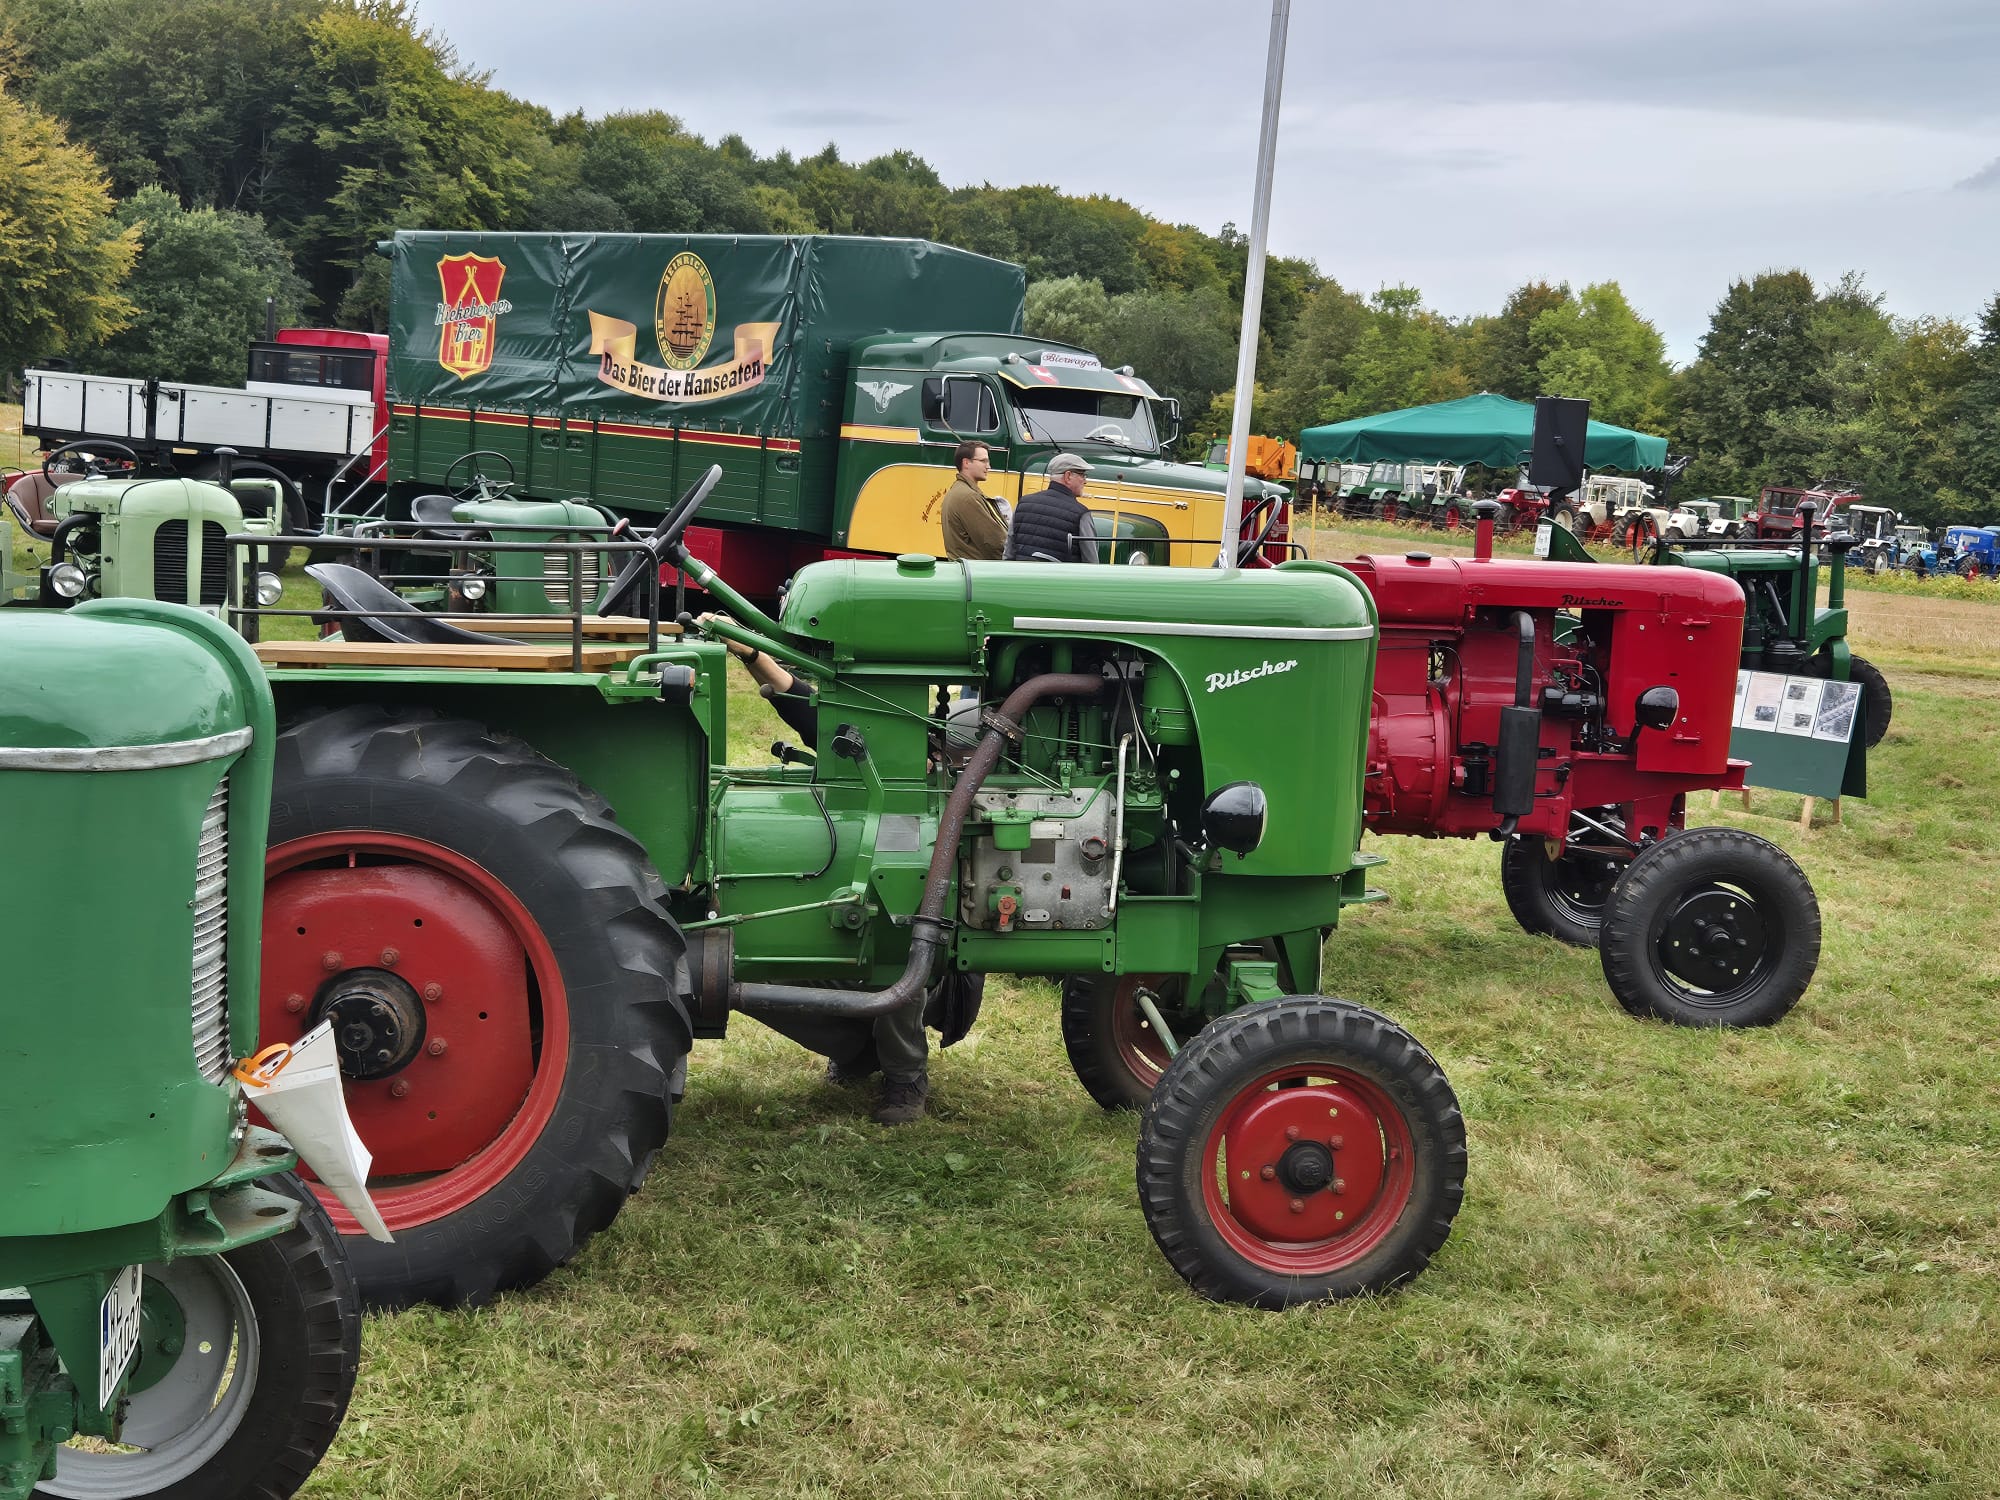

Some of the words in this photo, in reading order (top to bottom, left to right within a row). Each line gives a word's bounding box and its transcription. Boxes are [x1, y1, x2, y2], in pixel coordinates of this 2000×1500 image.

[455, 322, 483, 343] Bier
[1043, 353, 1098, 368] Bierwagen
[603, 352, 626, 383] Das
[628, 365, 656, 395] Bier
[658, 373, 682, 396] der
[684, 359, 761, 396] Hanseaten
[1561, 594, 1624, 607] Ritscher
[1205, 659, 1298, 693] Ritscher
